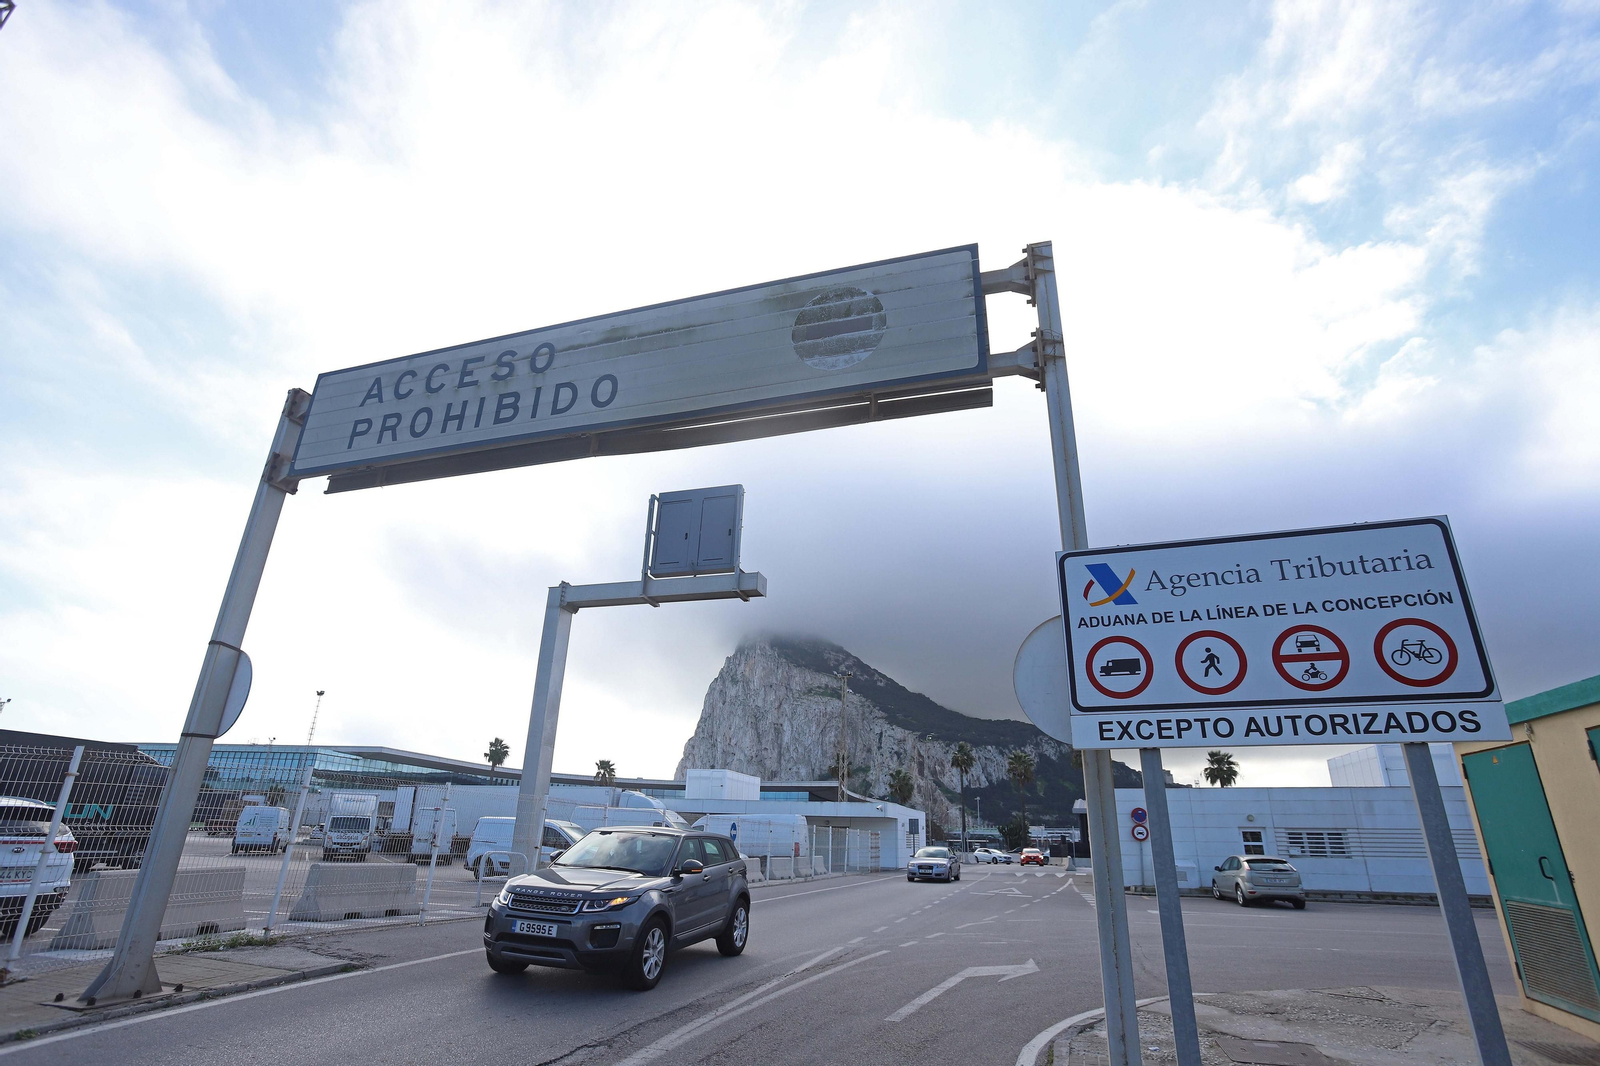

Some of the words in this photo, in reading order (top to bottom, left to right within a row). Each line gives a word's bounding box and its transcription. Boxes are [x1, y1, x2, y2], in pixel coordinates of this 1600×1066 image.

[360, 341, 556, 407] ACCESO
[347, 374, 619, 450] PROHIBIDO
[1144, 563, 1262, 597] Agencia
[1270, 549, 1436, 584] Tributaria
[1077, 611, 1148, 629] ADUANA
[1152, 611, 1176, 625] DE
[1179, 608, 1203, 622] LA
[1206, 602, 1260, 620] LÍNEA
[1263, 603, 1288, 617] DE
[1293, 601, 1319, 615] LA
[1322, 588, 1454, 613] CONCEPCIÓN
[1097, 716, 1235, 742] EXCEPTO
[1244, 709, 1483, 739] AUTORIZADOS
[515, 887, 545, 895] RANGE
